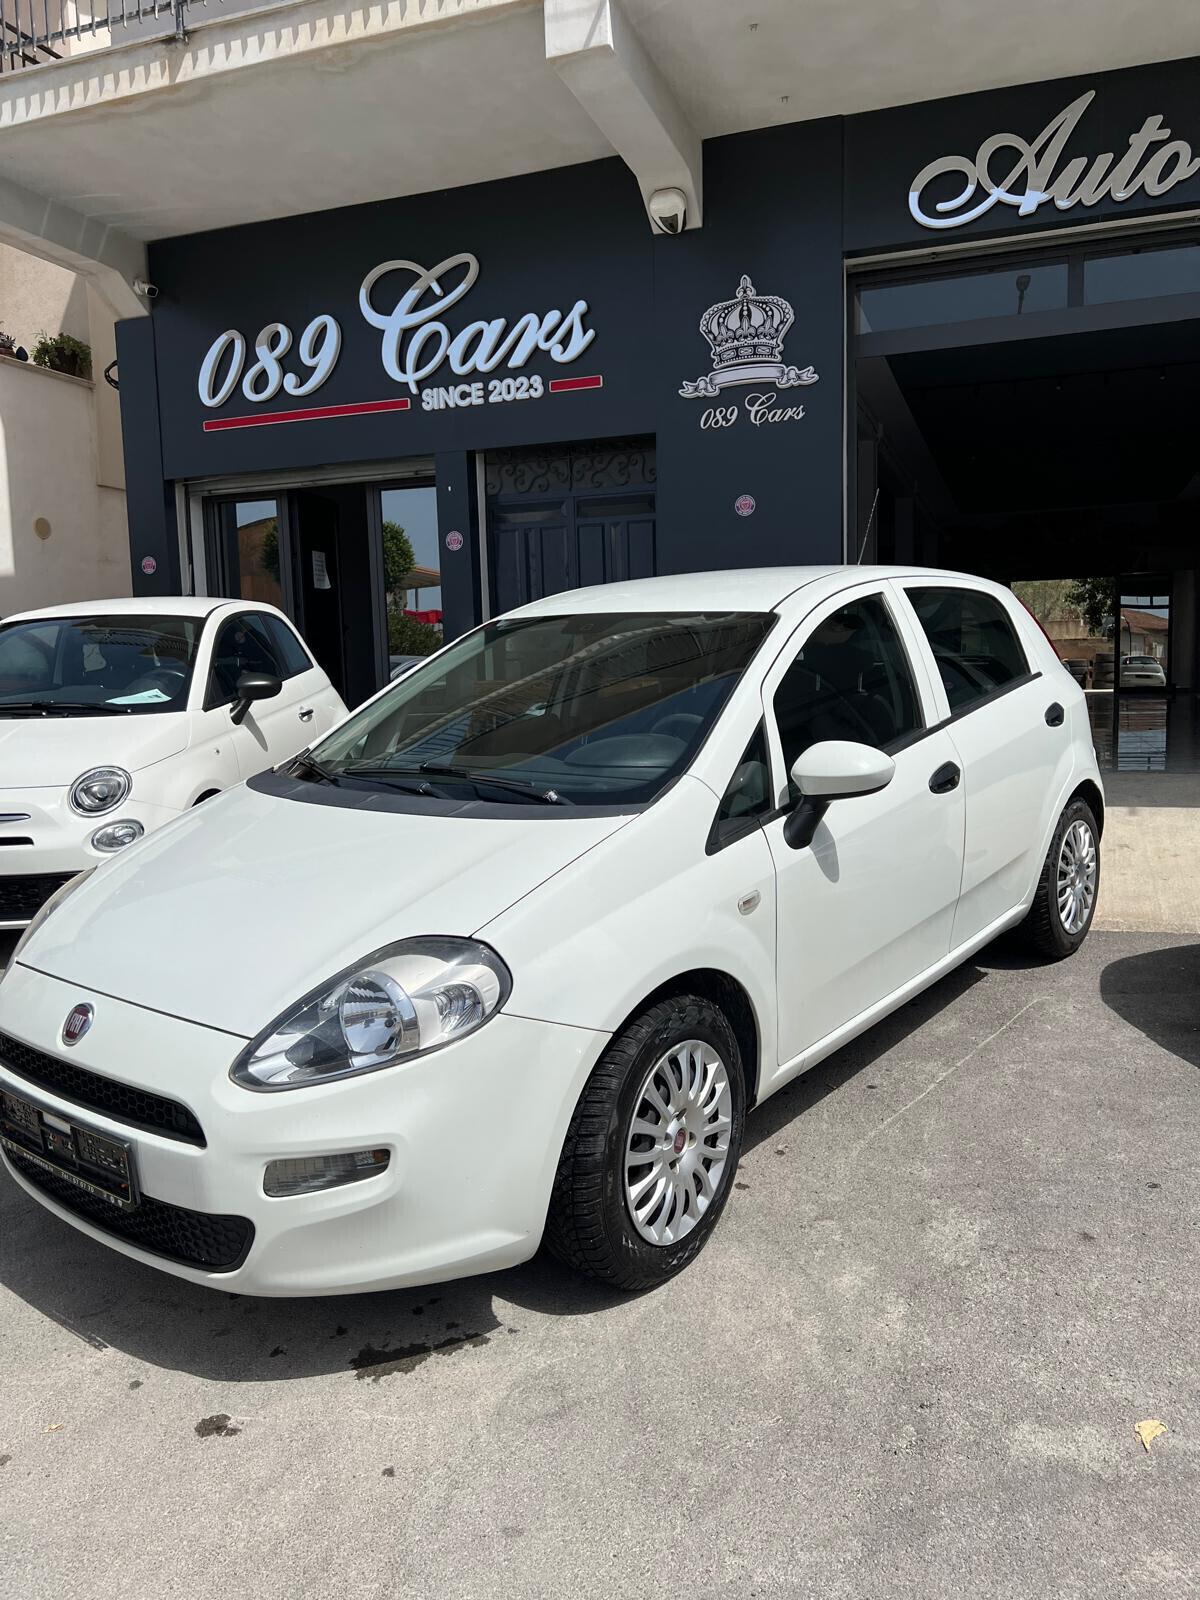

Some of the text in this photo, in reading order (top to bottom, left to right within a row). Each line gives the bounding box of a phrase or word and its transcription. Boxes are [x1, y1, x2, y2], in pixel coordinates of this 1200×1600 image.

[908, 89, 1200, 229] Auto
[198, 252, 596, 408] 089 Cars
[421, 374, 544, 411] SINCE 2023
[700, 392, 806, 429] 089 Cars
